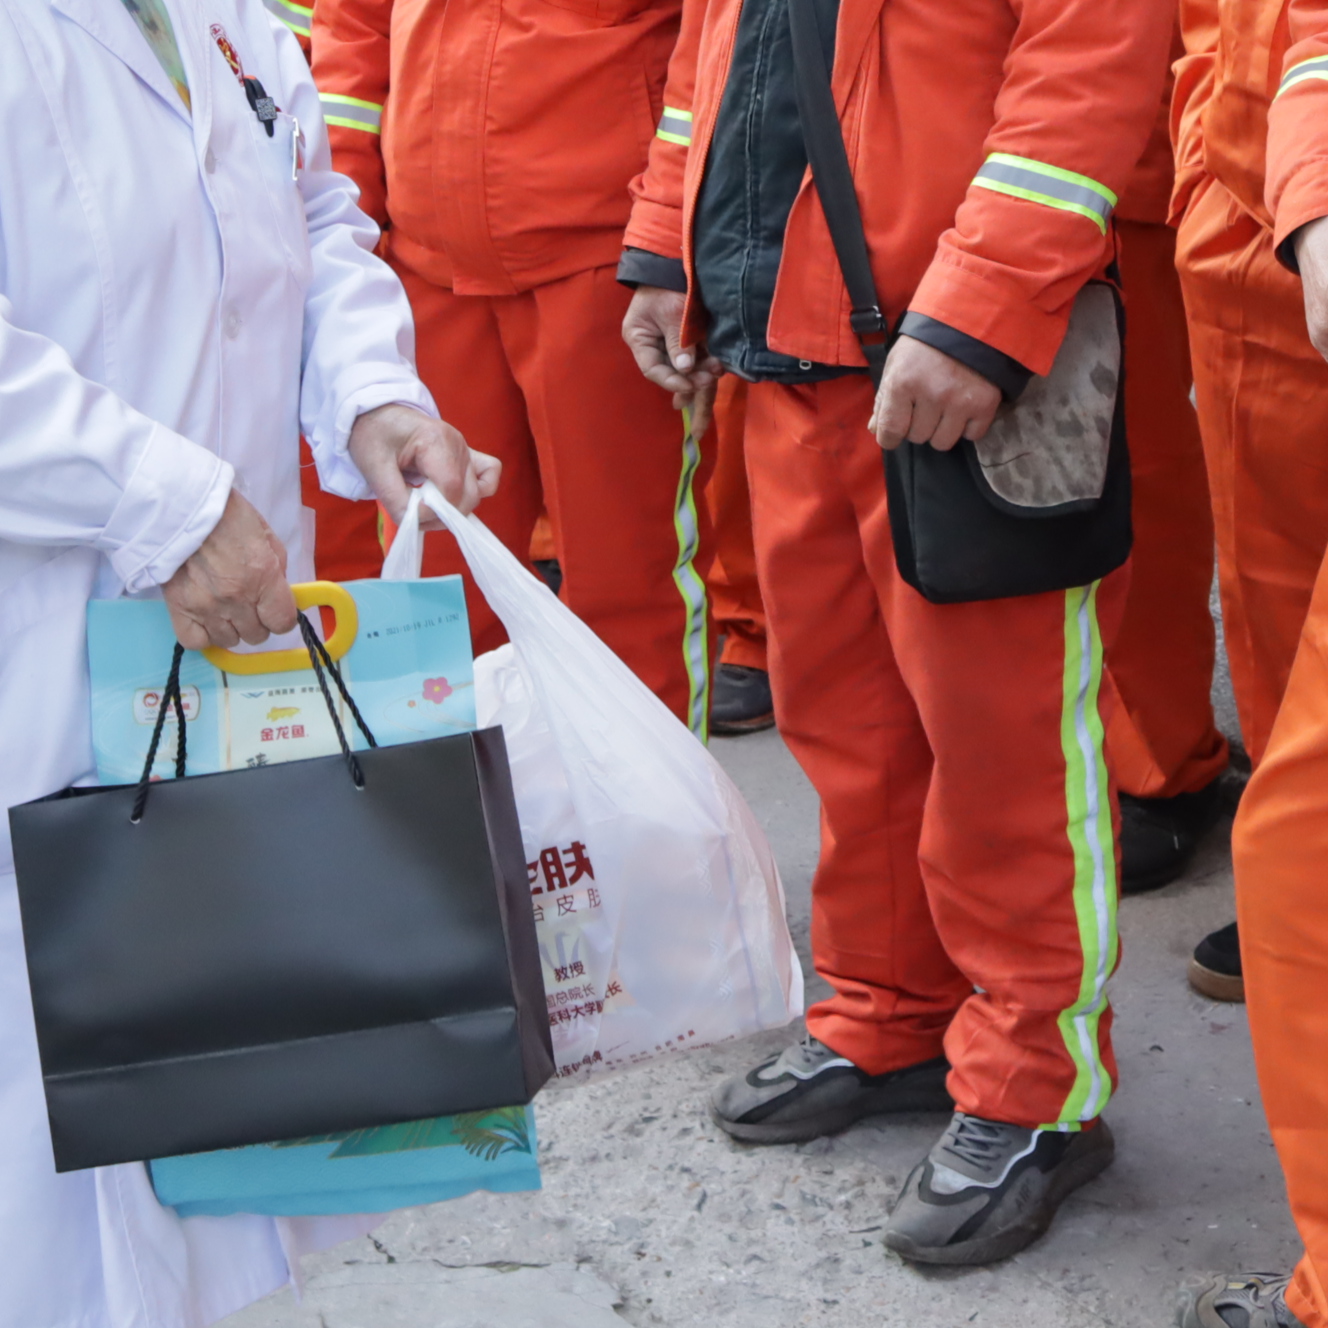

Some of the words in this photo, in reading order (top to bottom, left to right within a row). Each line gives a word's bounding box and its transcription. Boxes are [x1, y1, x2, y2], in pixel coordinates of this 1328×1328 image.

[260, 724, 306, 742] 金龙鱼
[554, 961, 585, 984] 教授
